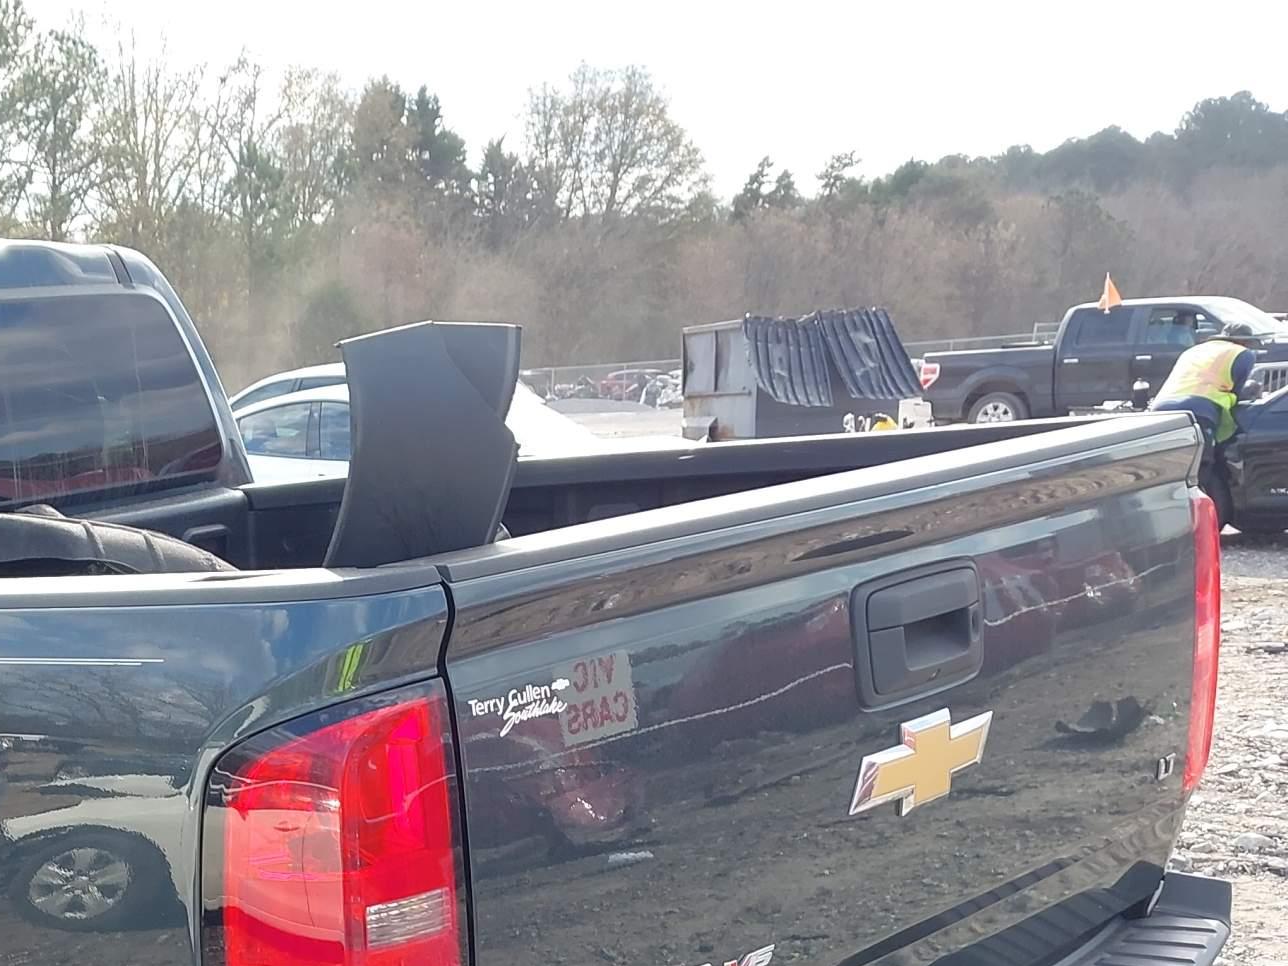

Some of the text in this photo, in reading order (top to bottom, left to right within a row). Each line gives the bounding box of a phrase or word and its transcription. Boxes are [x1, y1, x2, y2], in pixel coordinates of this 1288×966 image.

[468, 684, 551, 717] Terry Cullen
[500, 696, 568, 737] Southlake
